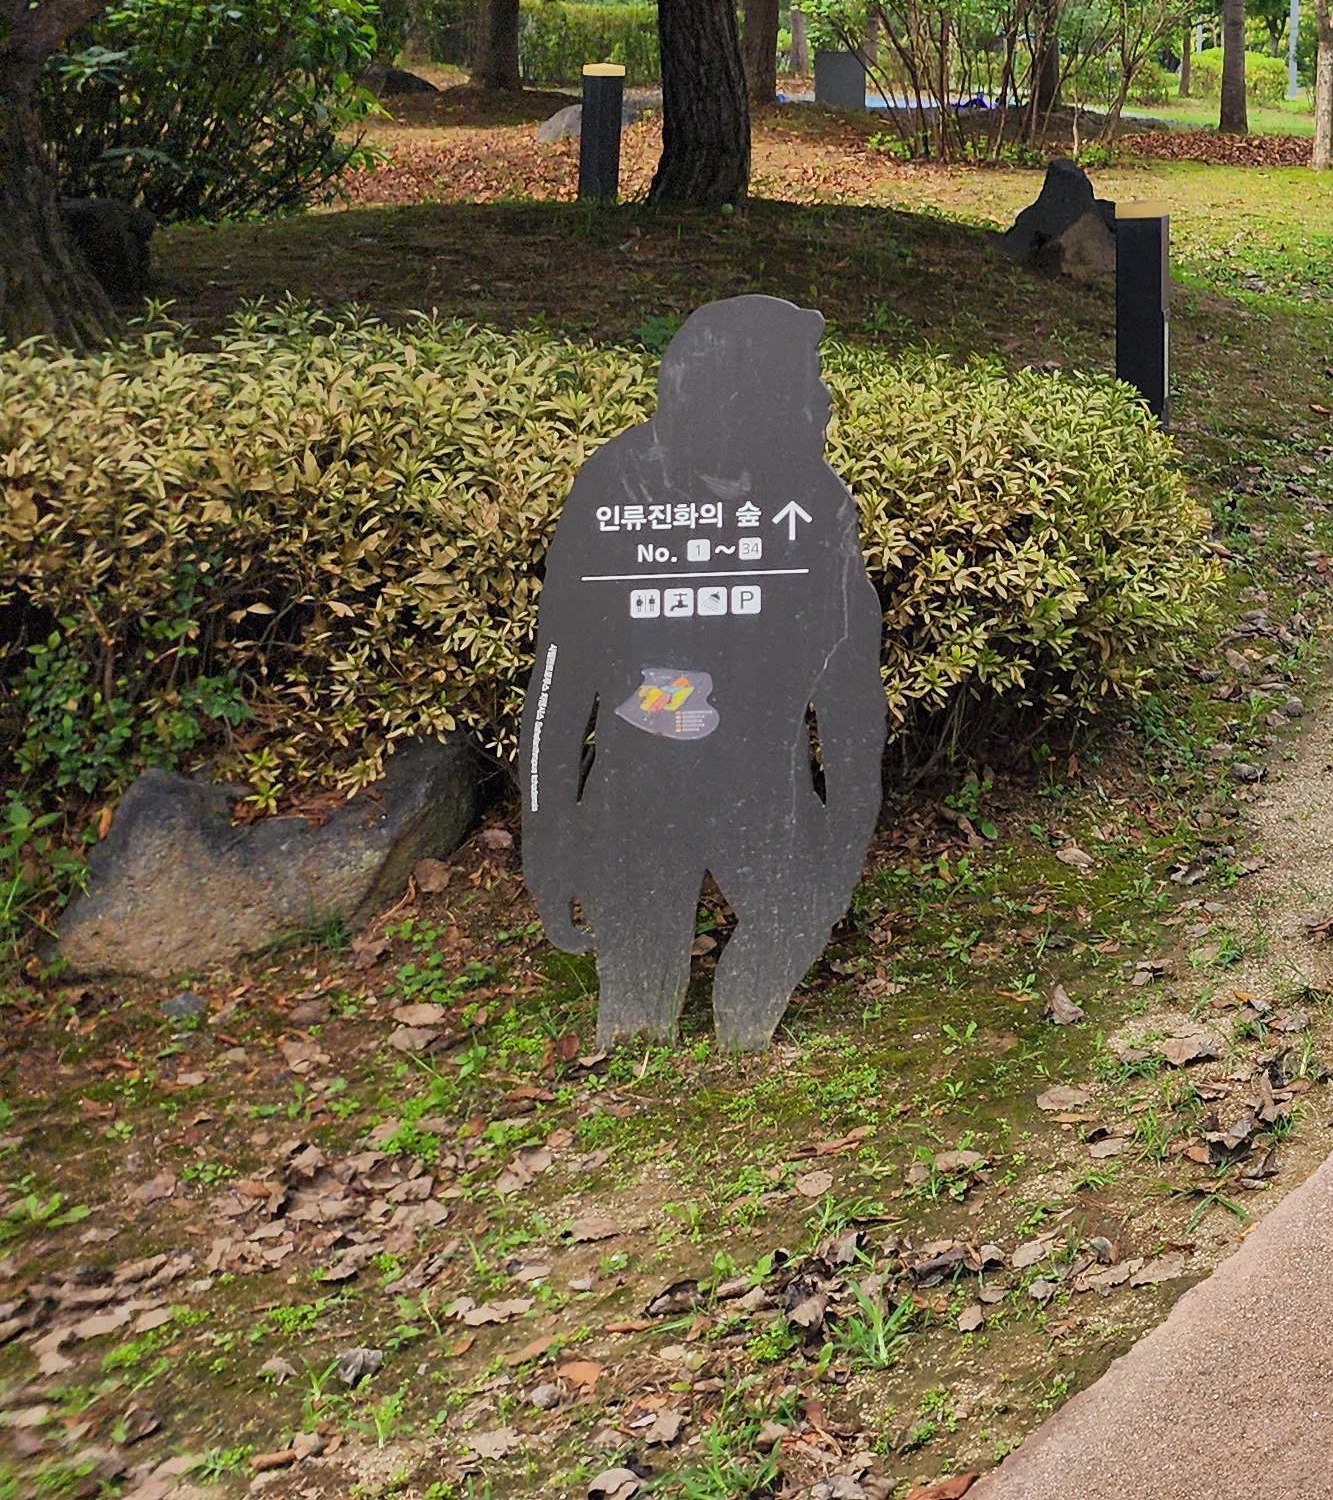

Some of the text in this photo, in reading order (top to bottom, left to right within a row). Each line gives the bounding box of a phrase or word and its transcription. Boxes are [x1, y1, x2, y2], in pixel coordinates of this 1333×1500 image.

[595, 500, 762, 532] 인류진화의 숲
[637, 543, 679, 563] No.
